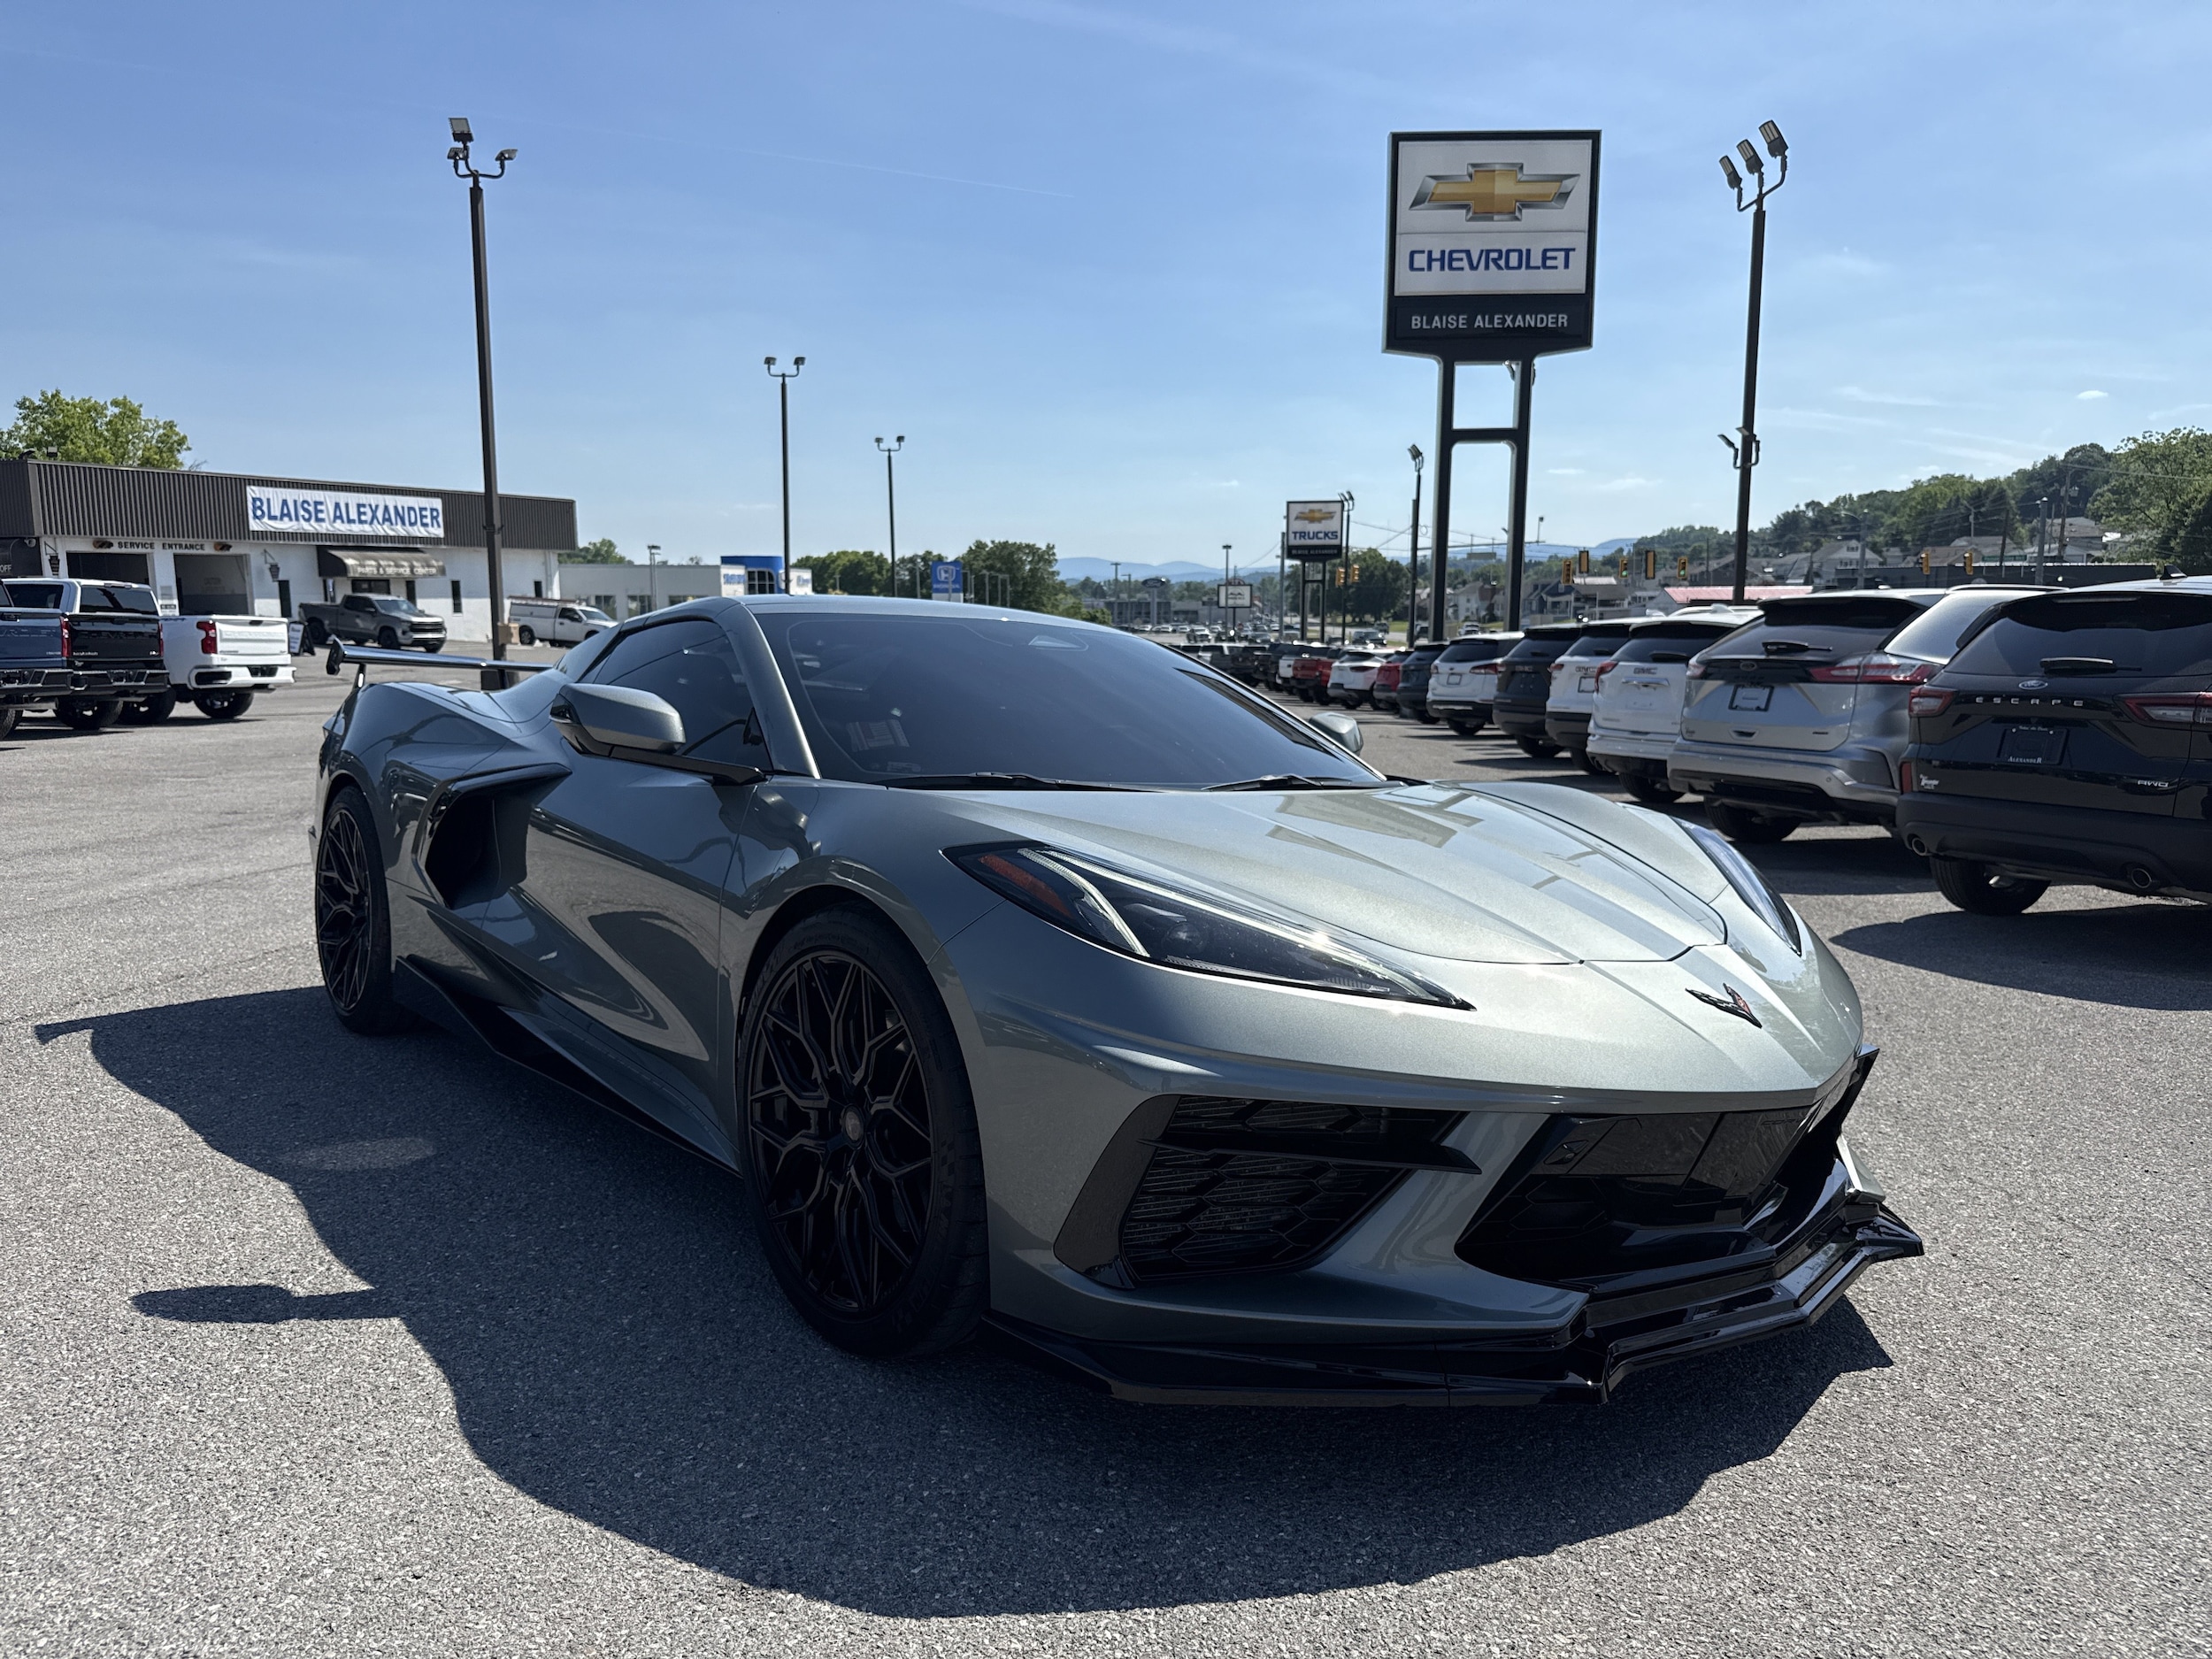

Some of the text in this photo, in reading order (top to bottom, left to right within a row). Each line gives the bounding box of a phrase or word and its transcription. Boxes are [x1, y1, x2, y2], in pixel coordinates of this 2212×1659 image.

[1409, 248, 1576, 272] CHEVROLET
[1410, 314, 1569, 330] BLAISE ALEXANDER
[251, 496, 442, 528] BLAISE ALEXANDER
[1292, 531, 1339, 541] TRUCKS
[118, 541, 205, 551] SERVICE ENTRANCE
[357, 566, 378, 575] PARTS
[379, 566, 385, 575] &
[385, 566, 411, 575] SERVICE
[1976, 696, 2084, 707] ESCAPE
